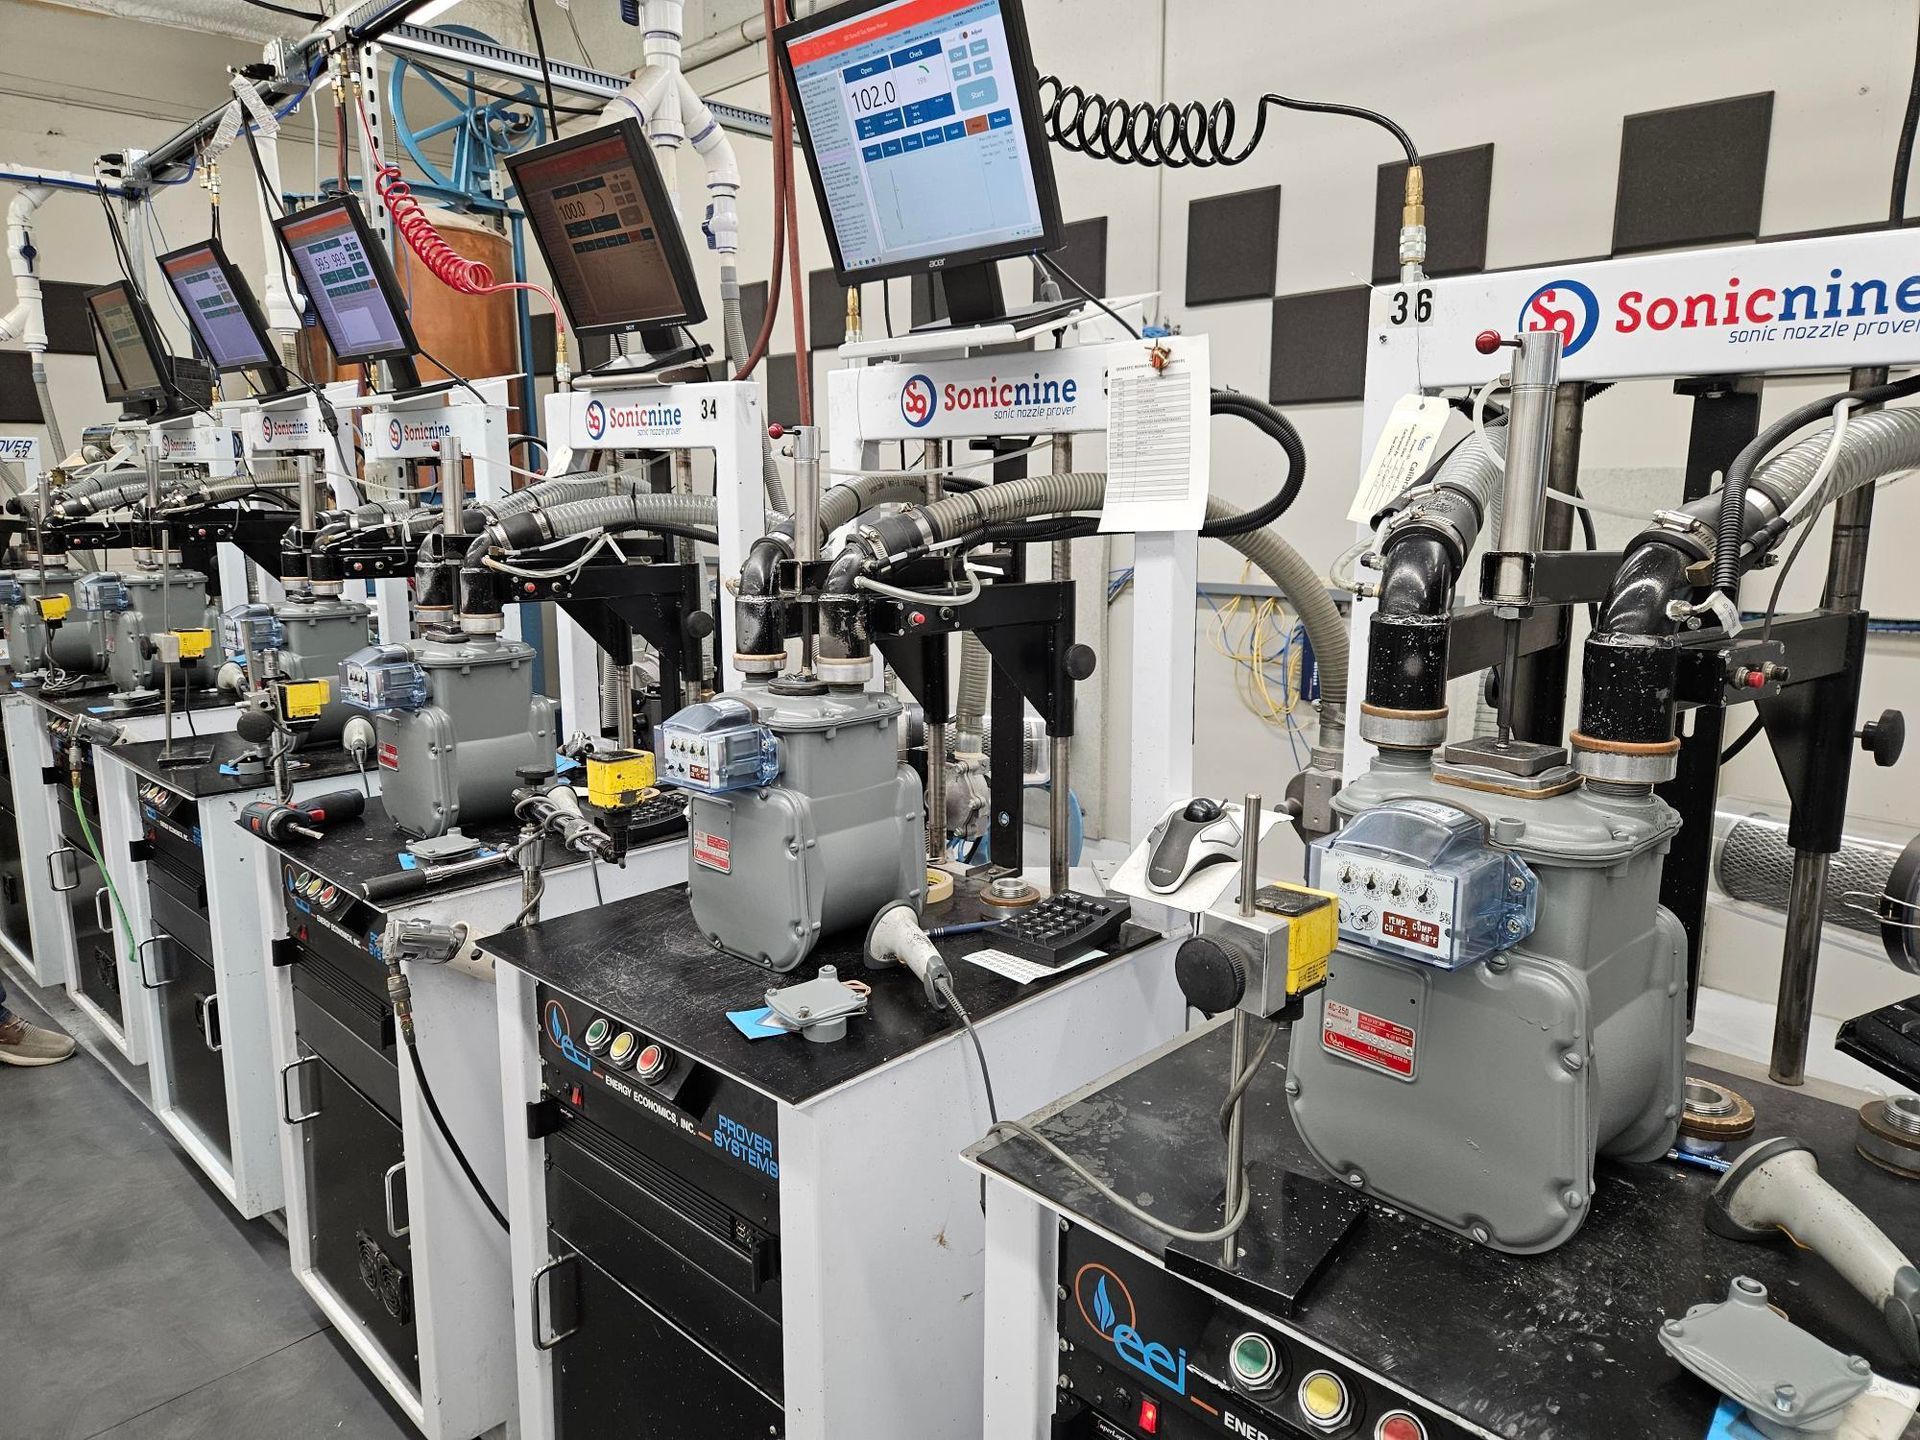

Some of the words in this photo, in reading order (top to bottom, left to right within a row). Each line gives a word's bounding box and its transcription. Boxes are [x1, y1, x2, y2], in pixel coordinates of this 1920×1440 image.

[909, 50, 923, 59] Check
[860, 66, 873, 75] Open
[851, 80, 896, 113] 102.0
[970, 90, 985, 99] Start
[559, 200, 586, 220] 100.0
[314, 256, 330, 271] 99.5
[331, 252, 347, 267] 99.9
[929, 258, 946, 268] acer
[1390, 288, 1433, 326] 36
[1615, 269, 1920, 333] Sonicnine
[1728, 325, 1778, 343] sonic
[1783, 320, 1850, 340] nozzle
[1853, 318, 1920, 341] prover
[944, 372, 1077, 411] Sonicnine
[610, 403, 682, 428] Sonicnine
[701, 399, 717, 420] 34
[993, 409, 1015, 420] sonic
[1017, 407, 1045, 419] nozzle
[1046, 405, 1076, 419] prover
[273, 416, 309, 435] Sonicnine
[318, 419, 326, 432] 32
[404, 421, 450, 441] Sonicnine
[364, 432, 373, 447] 33
[15, 450, 28, 458] 22
[1384, 924, 1396, 933] CU.
[1400, 928, 1410, 937] FT.
[1388, 916, 1408, 928] TEMP.
[1412, 921, 1434, 935] COMP.
[605, 1075, 632, 1098] ENERGY
[633, 1091, 679, 1127] ECONOMICS,
[681, 1117, 696, 1135] INC.
[718, 1113, 772, 1158] PROVER
[714, 1129, 779, 1179] SYSTEMS
[1223, 1411, 1270, 1440] ENER
